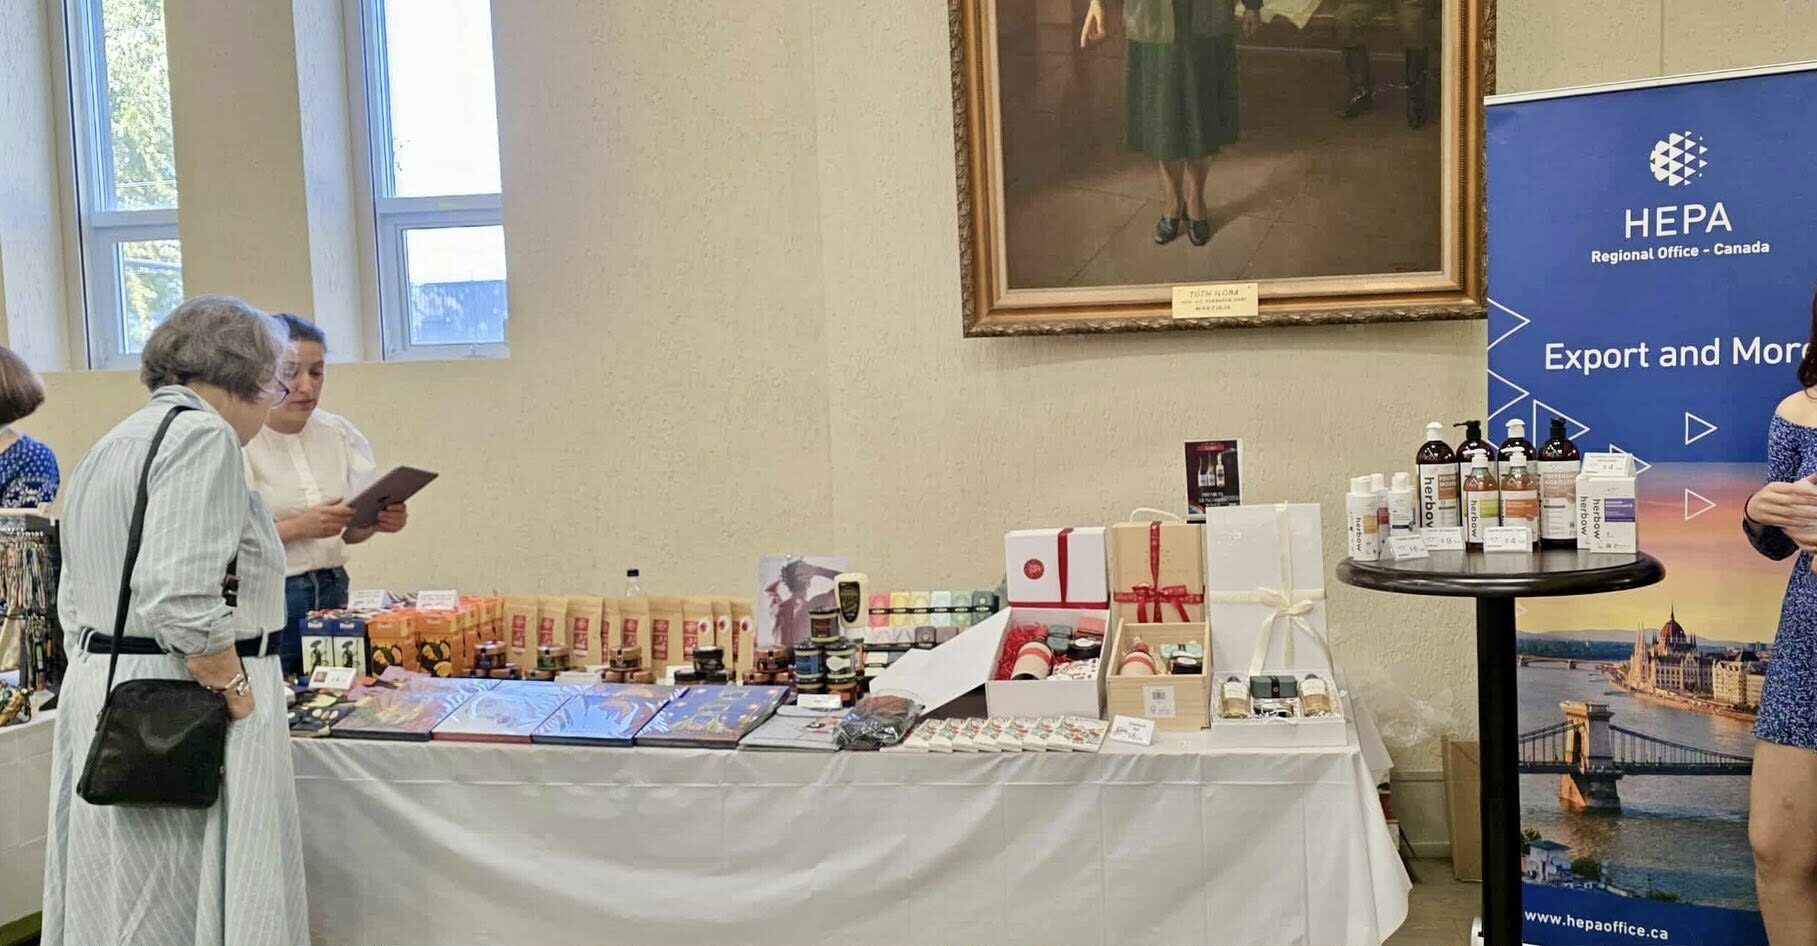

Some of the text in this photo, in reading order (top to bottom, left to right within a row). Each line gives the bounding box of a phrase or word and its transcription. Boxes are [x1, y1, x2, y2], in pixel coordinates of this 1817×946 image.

[1624, 202, 1733, 239] HEPA
[1591, 247, 1654, 265] Regional
[1657, 245, 1699, 259] Office
[1714, 240, 1770, 255] Canada
[1545, 342, 1649, 376] Export
[1659, 337, 1720, 367] and
[1355, 517, 1363, 552] herbow
[1471, 500, 1480, 538] herbow
[1580, 496, 1590, 536] herbow
[1593, 498, 1603, 540] herbow
[1524, 910, 1669, 940] www.hepaoffice.ca
